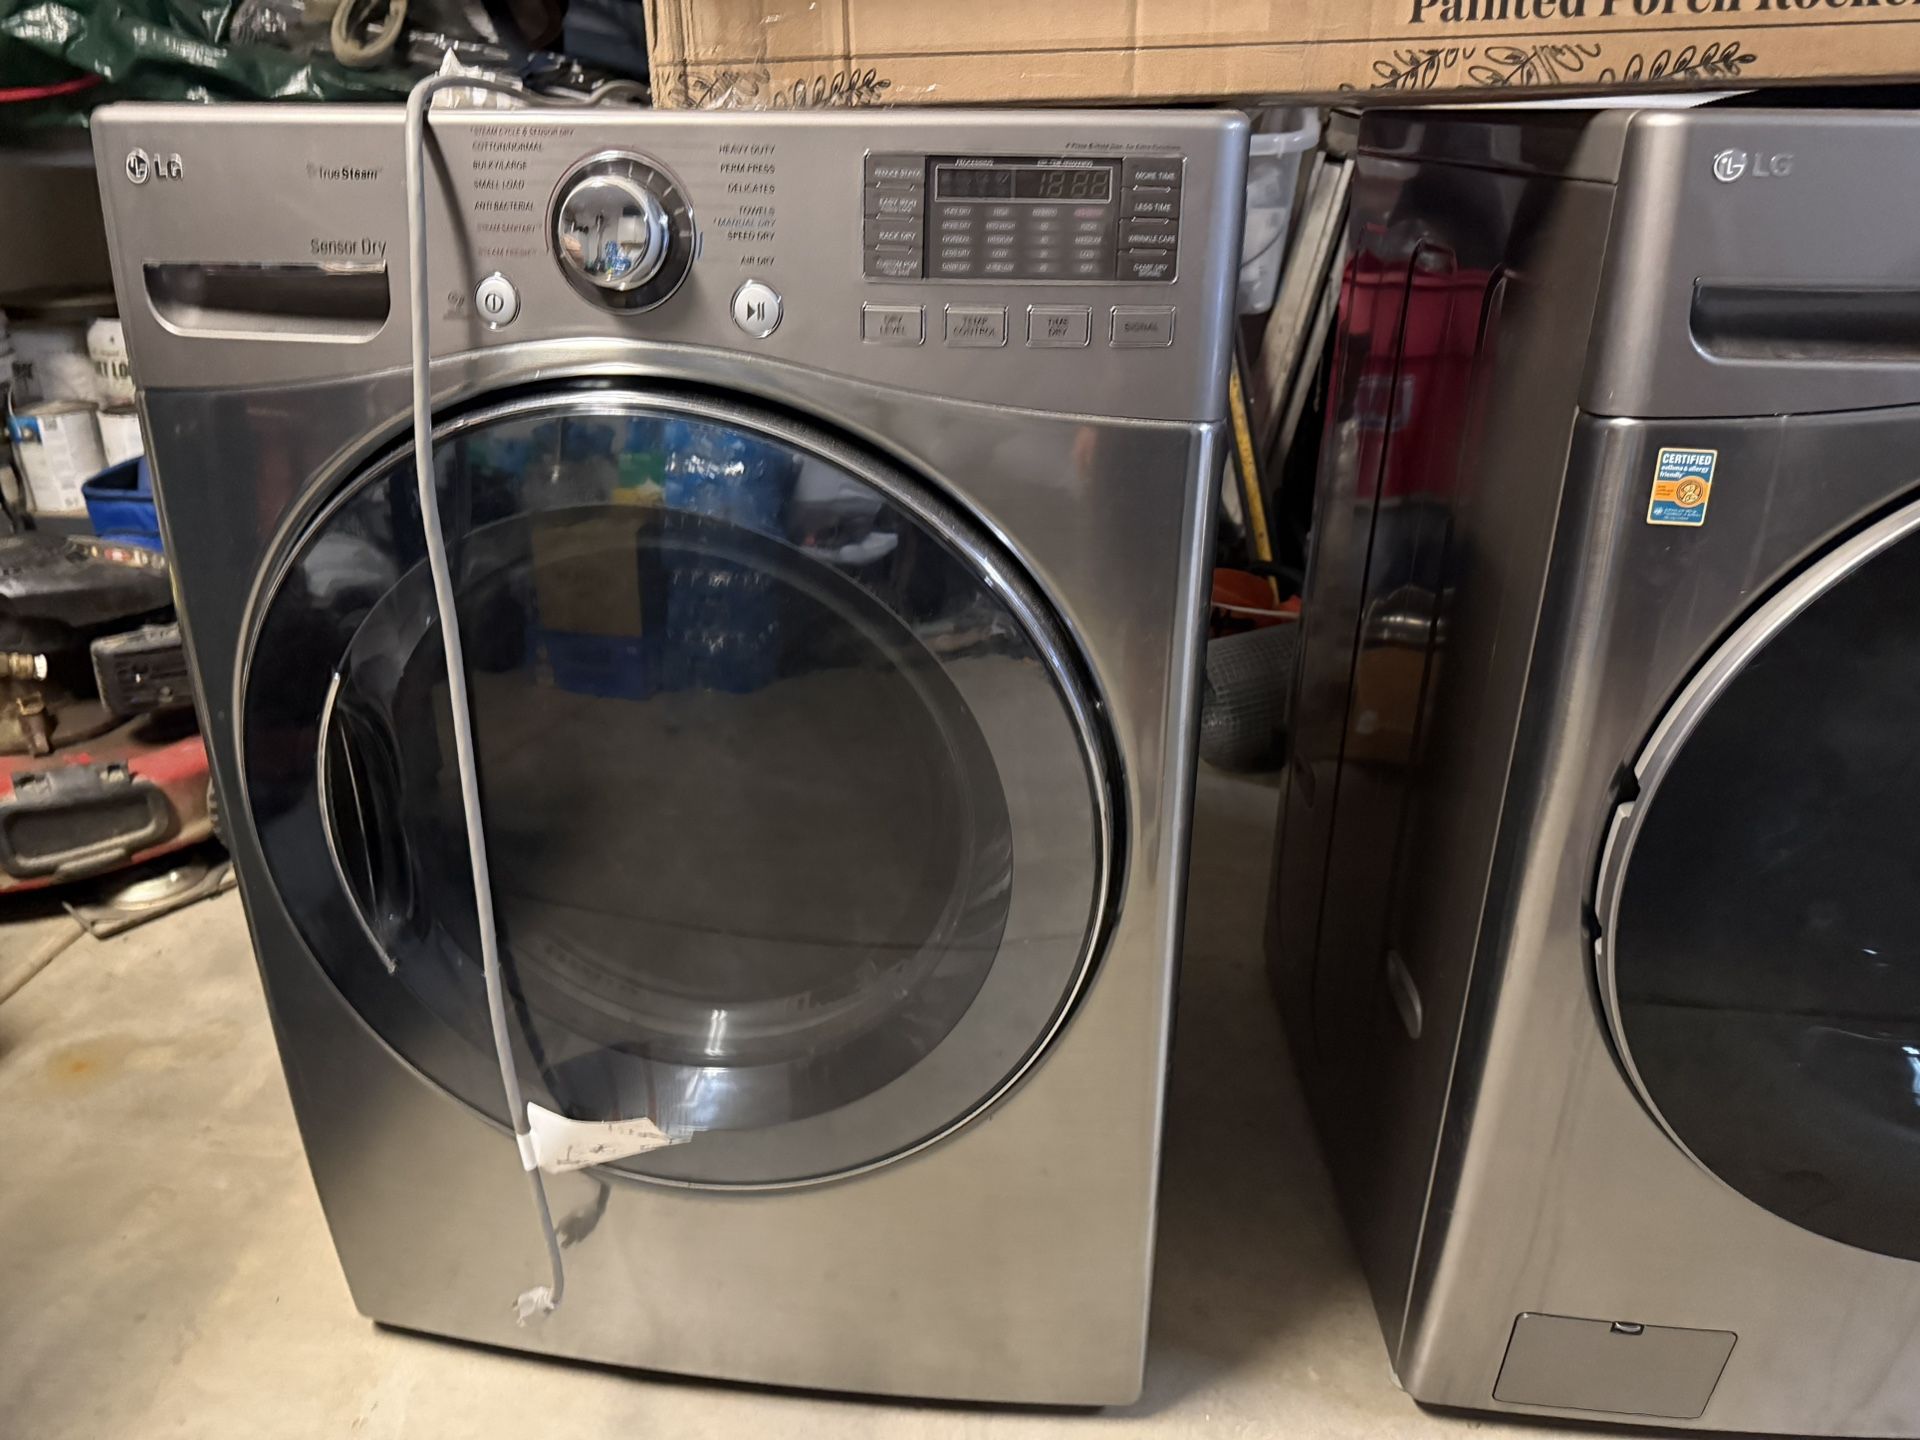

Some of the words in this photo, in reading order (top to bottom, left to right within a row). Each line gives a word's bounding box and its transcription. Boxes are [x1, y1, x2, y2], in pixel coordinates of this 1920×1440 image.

[1752, 152, 1794, 177] LG
[310, 238, 356, 256] Sensor
[361, 238, 387, 259] Dry
[1662, 453, 1713, 466] CERTIFIED
